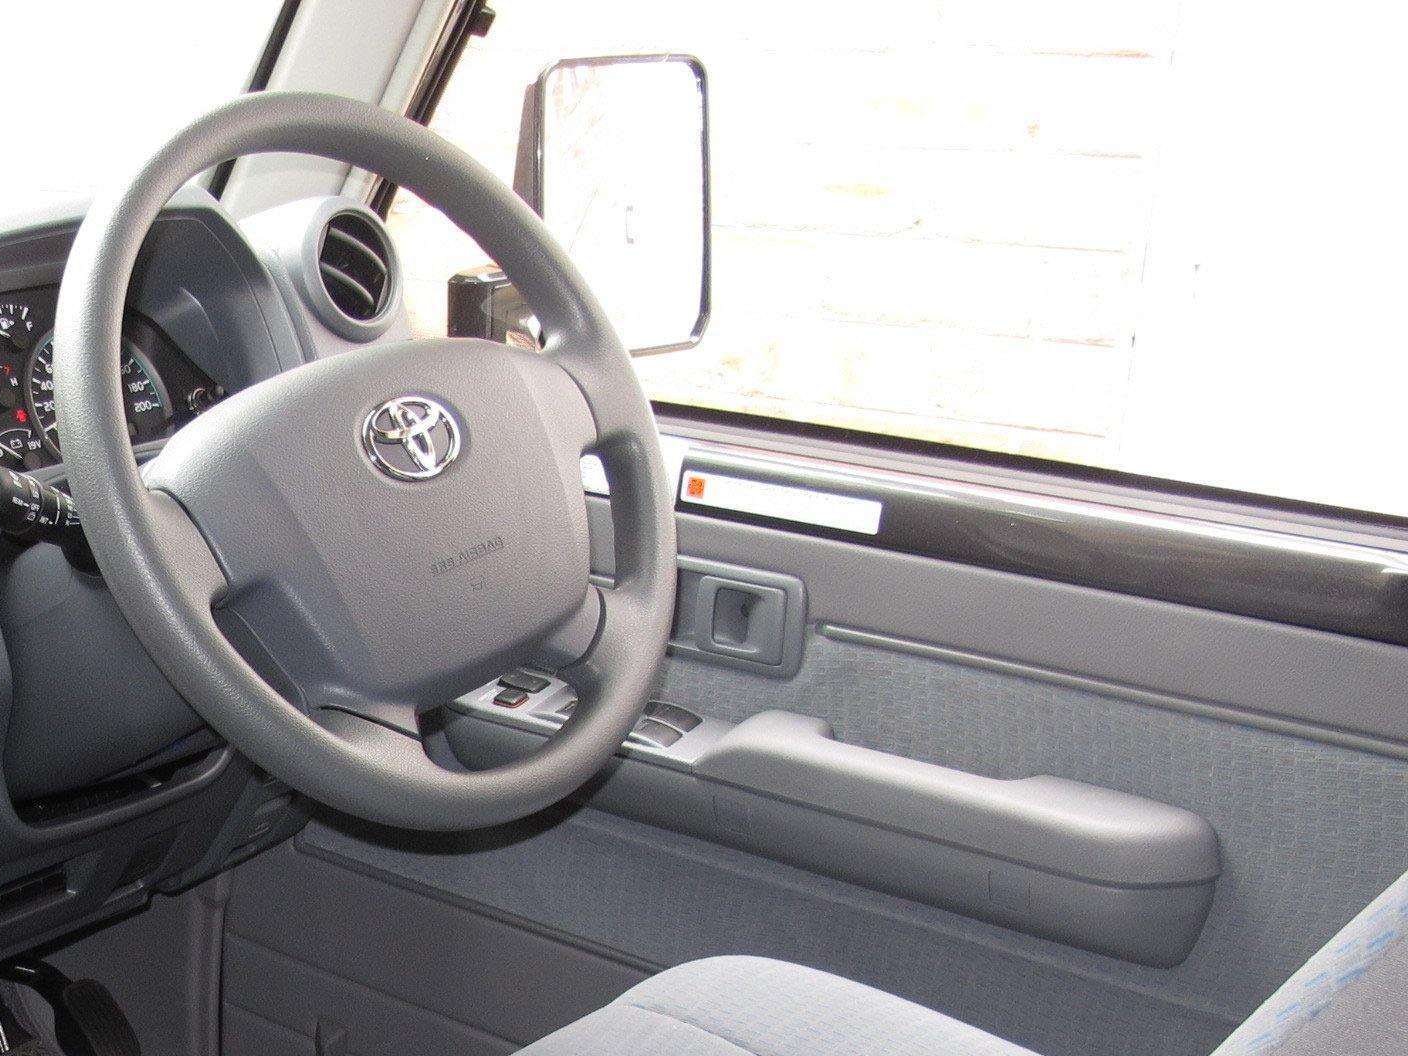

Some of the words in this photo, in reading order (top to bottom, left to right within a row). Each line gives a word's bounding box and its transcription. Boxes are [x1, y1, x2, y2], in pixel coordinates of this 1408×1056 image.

[25, 321, 33, 331] F
[10, 377, 18, 387] H
[41, 380, 54, 391] 40
[127, 381, 144, 394] 180
[134, 400, 152, 413] 200
